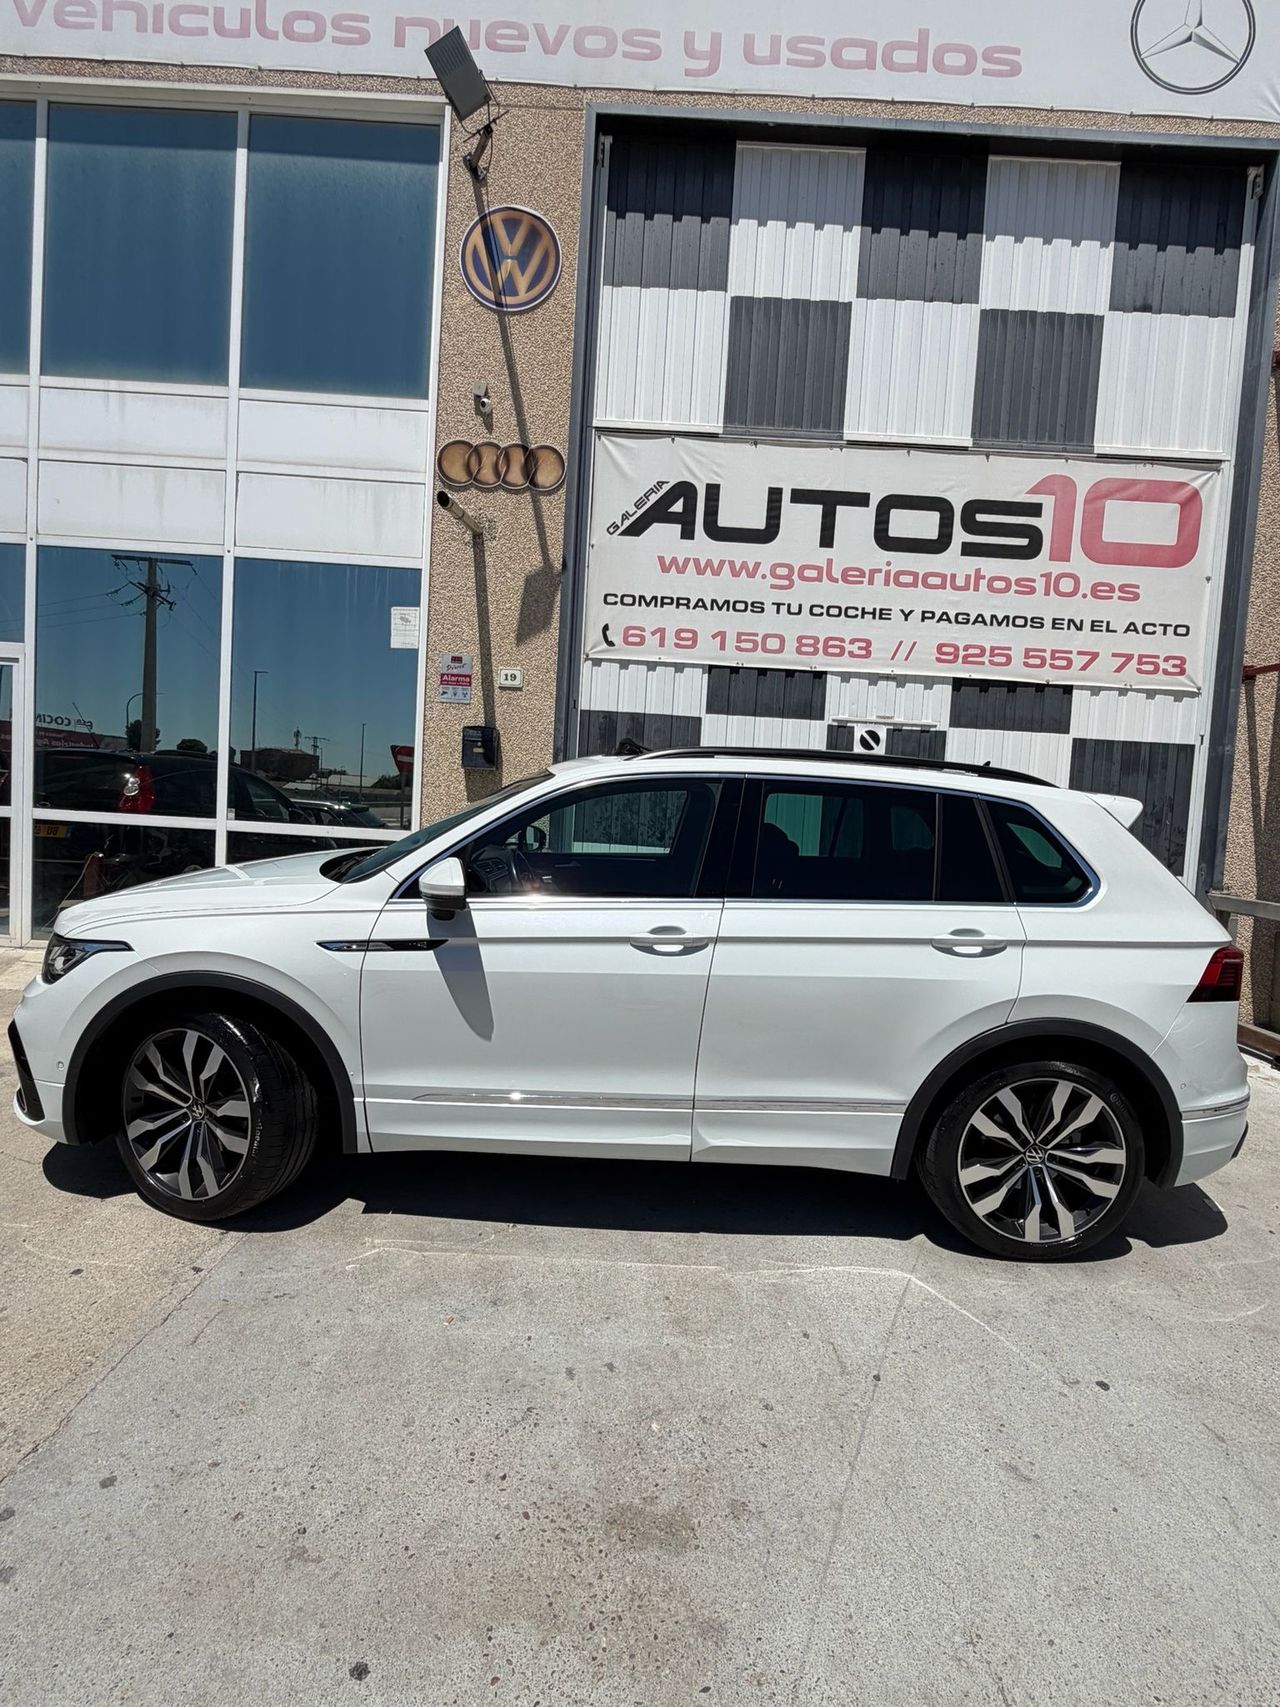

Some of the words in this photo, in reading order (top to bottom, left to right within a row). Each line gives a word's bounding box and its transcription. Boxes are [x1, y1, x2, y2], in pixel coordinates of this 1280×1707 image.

[393, 16, 663, 62] nuevos
[683, 31, 722, 78] y
[742, 28, 1023, 79] usados
[606, 480, 670, 537] GALERIA
[656, 555, 1142, 603] www.galeriaautos10.es
[603, 593, 765, 614] COMPRAMOS
[771, 602, 803, 616] TU
[808, 604, 893, 621] COCHE
[898, 608, 916, 622] Y
[920, 610, 1045, 630] PAGAMOS
[1051, 617, 1084, 632] EN
[1089, 619, 1119, 634] EL
[1122, 621, 1191, 637] ACTO
[621, 625, 699, 650] 619
[710, 630, 787, 654] 150
[795, 634, 873, 660] 863
[934, 642, 1013, 667] 925
[1022, 647, 1100, 673] 557
[1111, 651, 1188, 677] 753
[442, 674, 470, 682] Alarma
[503, 673, 517, 682] 19
